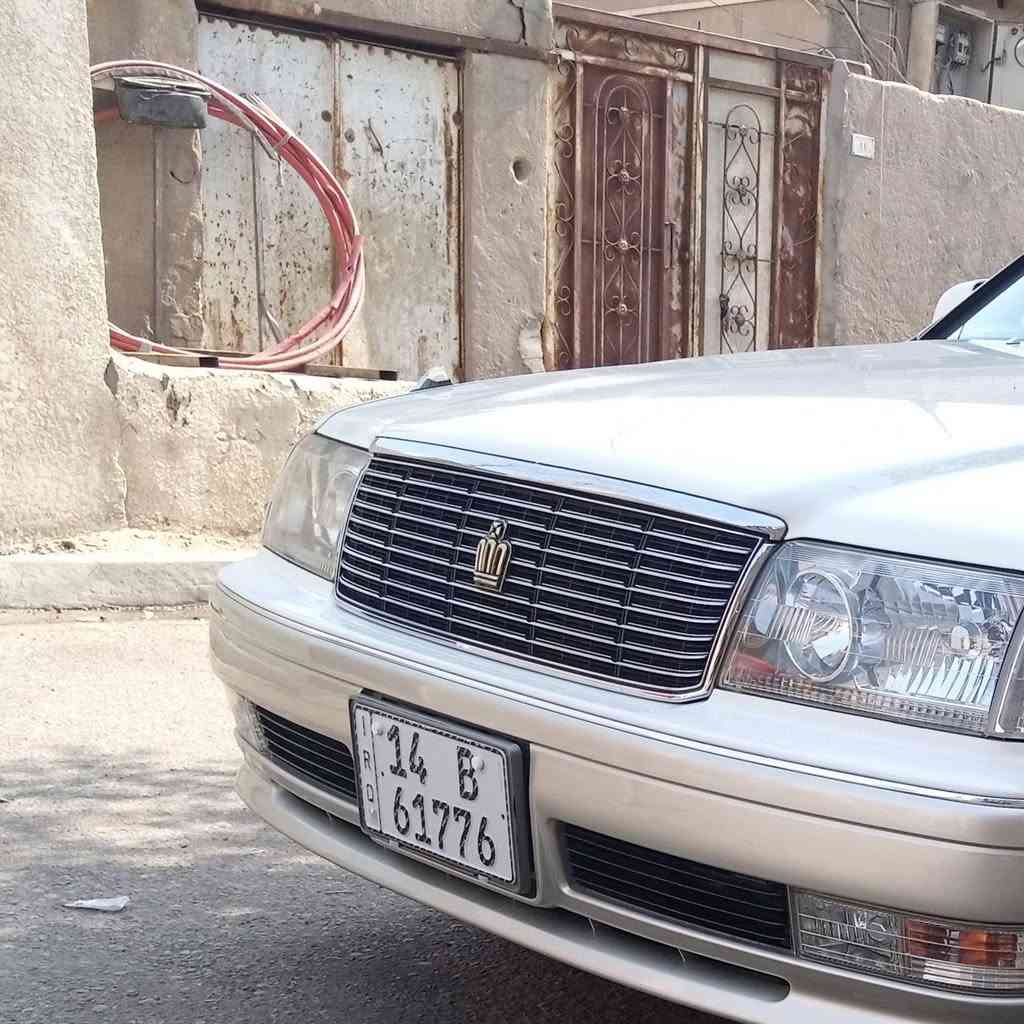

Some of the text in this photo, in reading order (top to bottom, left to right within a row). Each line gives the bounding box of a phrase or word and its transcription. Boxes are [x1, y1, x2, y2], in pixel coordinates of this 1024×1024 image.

[387, 724, 479, 801] 14 B
[393, 786, 496, 866] 61776
